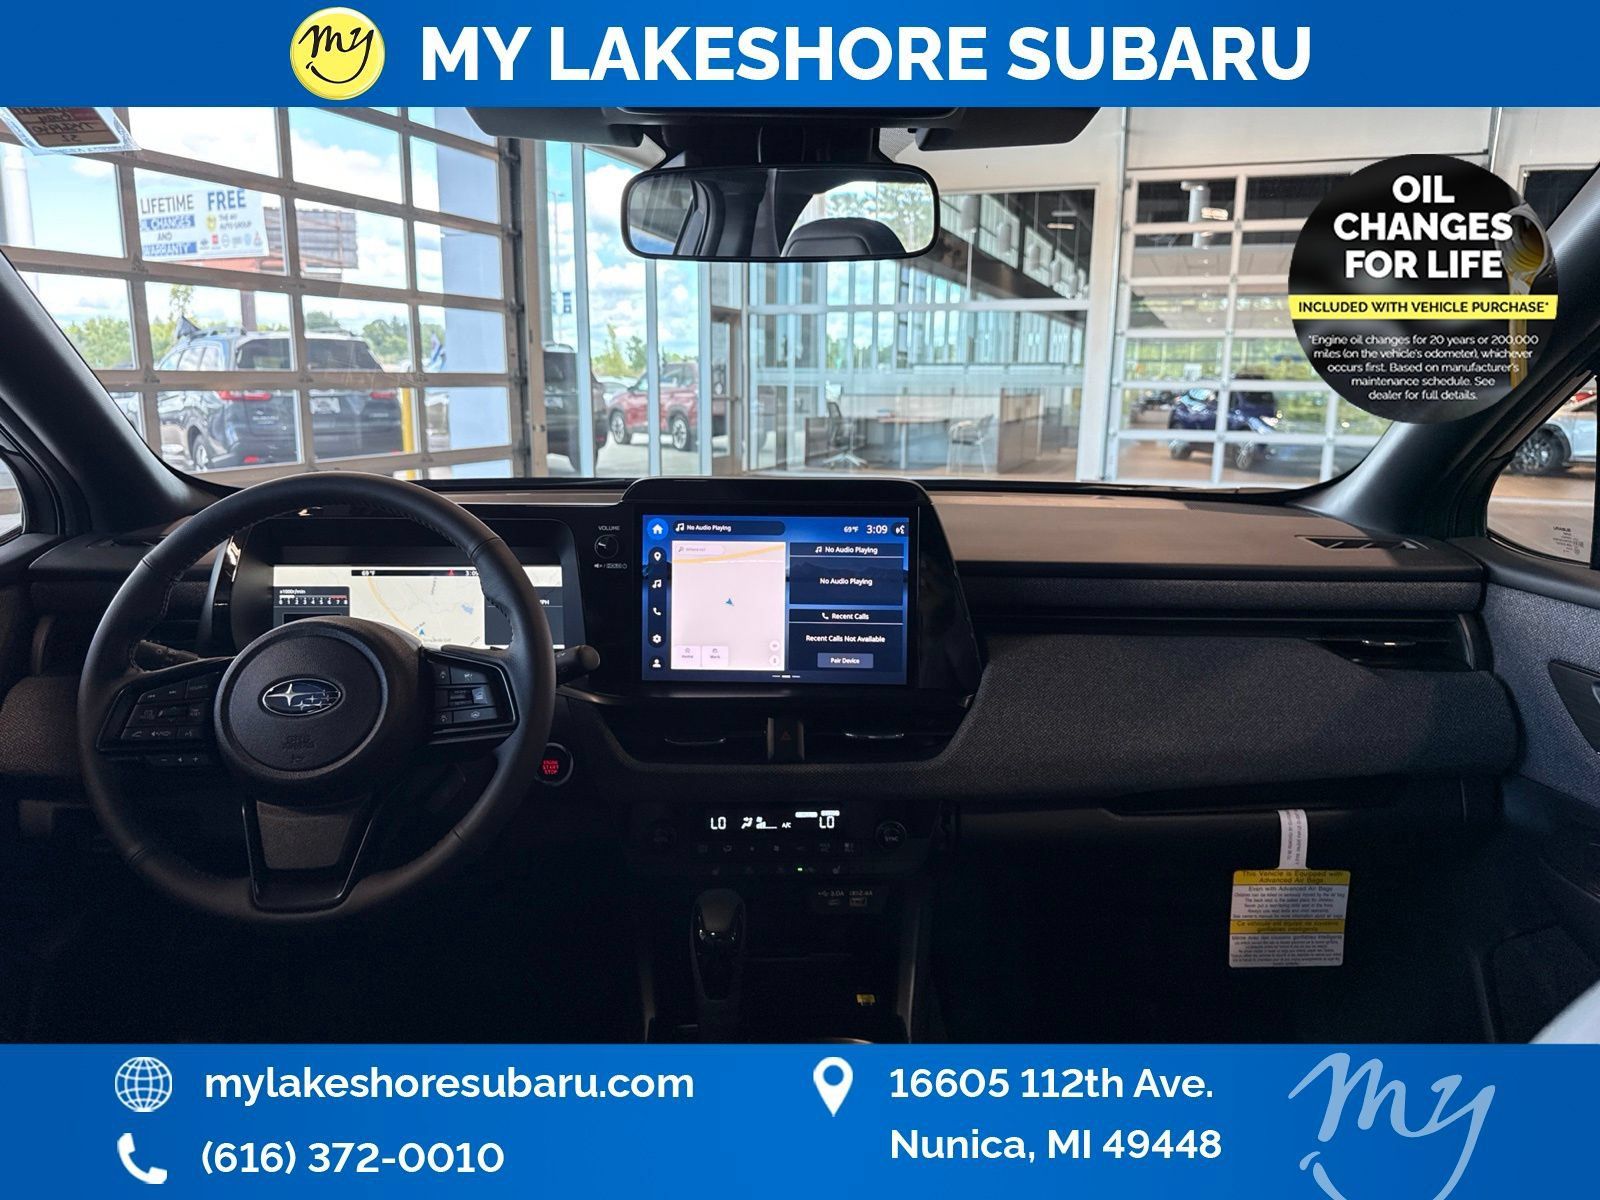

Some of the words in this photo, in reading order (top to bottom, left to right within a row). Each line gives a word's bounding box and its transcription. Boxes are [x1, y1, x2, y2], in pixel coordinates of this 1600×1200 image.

[140, 194, 195, 214] LIFETIME
[207, 189, 247, 211] FREE
[686, 524, 695, 532] No
[696, 524, 710, 532] Audio
[712, 524, 731, 533] Playing
[866, 525, 888, 534] 3:09
[825, 546, 834, 555] No
[834, 546, 852, 555] Audio
[853, 546, 879, 555] Playing
[820, 577, 828, 586] No
[829, 577, 846, 586] Audio
[848, 577, 873, 587] Playing
[831, 612, 852, 621] Recent
[853, 612, 869, 621] Calls
[806, 635, 827, 643] Recent
[827, 635, 843, 643] Calls
[844, 635, 856, 643] Not
[857, 635, 886, 643] Available
[710, 816, 727, 830] LO
[819, 815, 835, 829] LO
